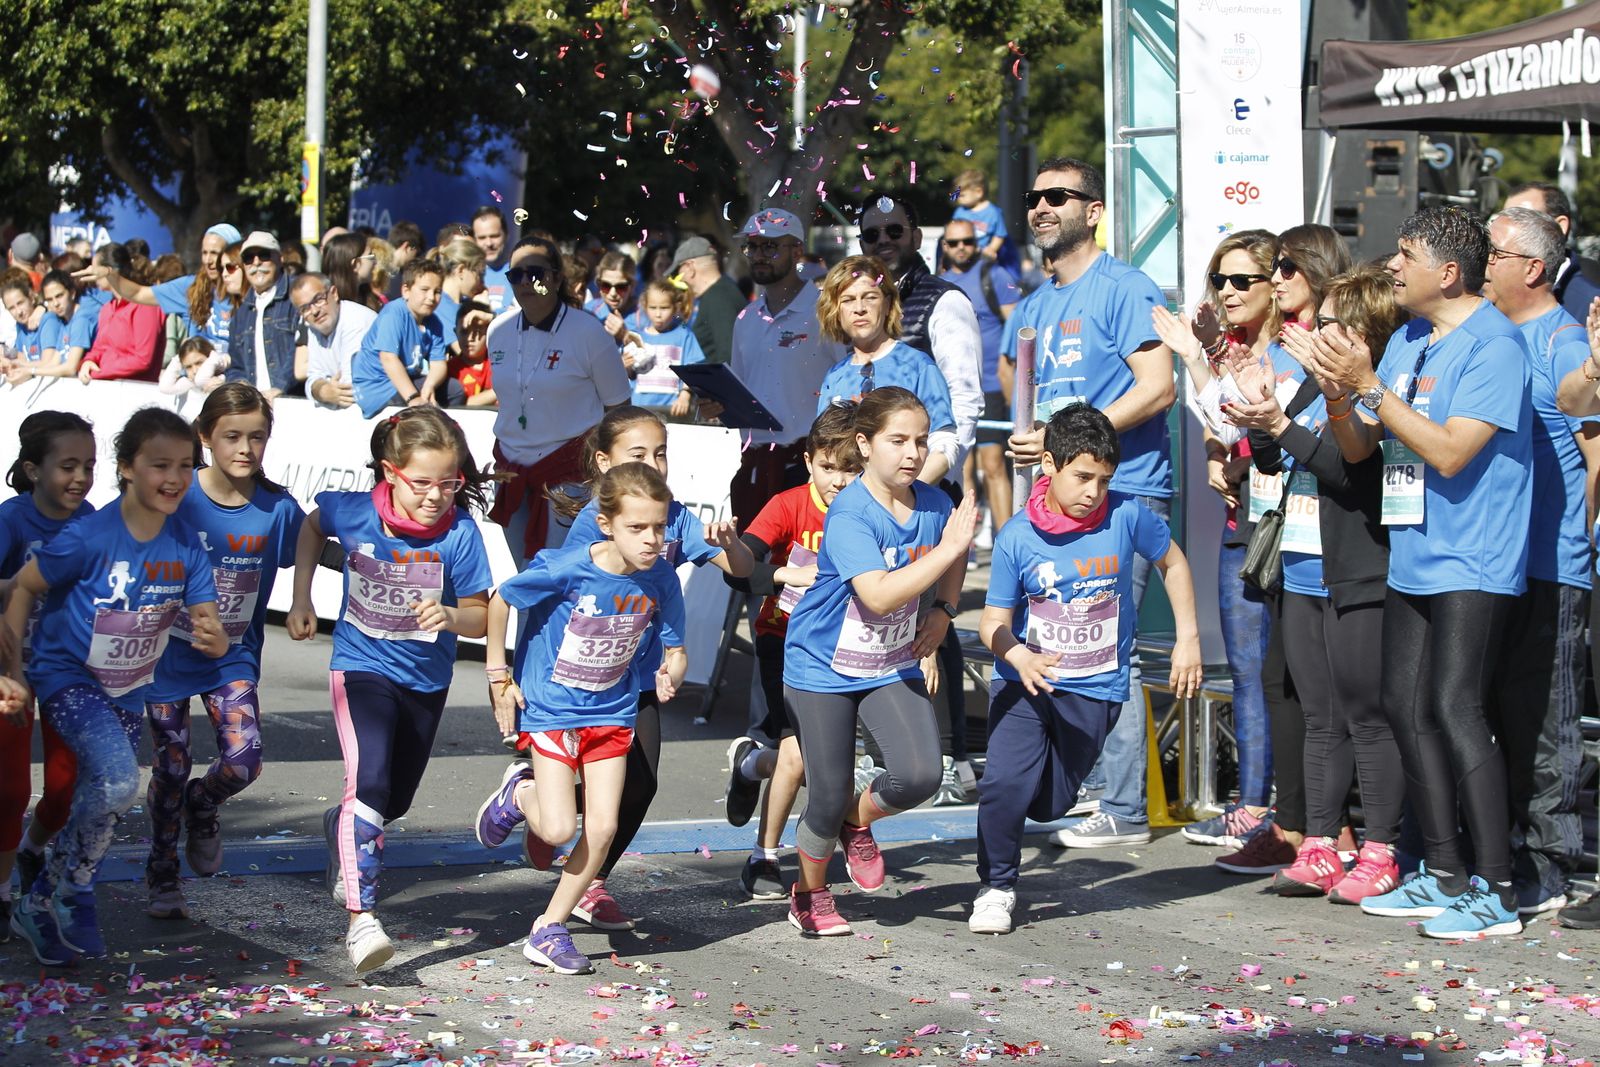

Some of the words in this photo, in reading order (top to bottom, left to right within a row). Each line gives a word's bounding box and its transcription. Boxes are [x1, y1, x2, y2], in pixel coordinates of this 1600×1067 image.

[1233, 32, 1246, 44] 15
[1226, 124, 1252, 135] Clece
[1229, 152, 1270, 165] cajamar
[1223, 181, 1260, 205] ego
[1385, 464, 1416, 486] 2278
[144, 561, 185, 580] VIII
[390, 564, 407, 573] VIII
[1074, 556, 1119, 576] VIII
[360, 577, 424, 607] 3263
[1072, 577, 1118, 590] CARRERA
[364, 599, 412, 614] LEONORCITA
[619, 616, 635, 624] VIII
[858, 619, 911, 645] 3112
[1042, 621, 1104, 645] 3060
[108, 638, 158, 659] 3081
[579, 639, 640, 659] 3255
[1055, 643, 1089, 651] ALFREDO
[577, 656, 611, 665] DANIELA
